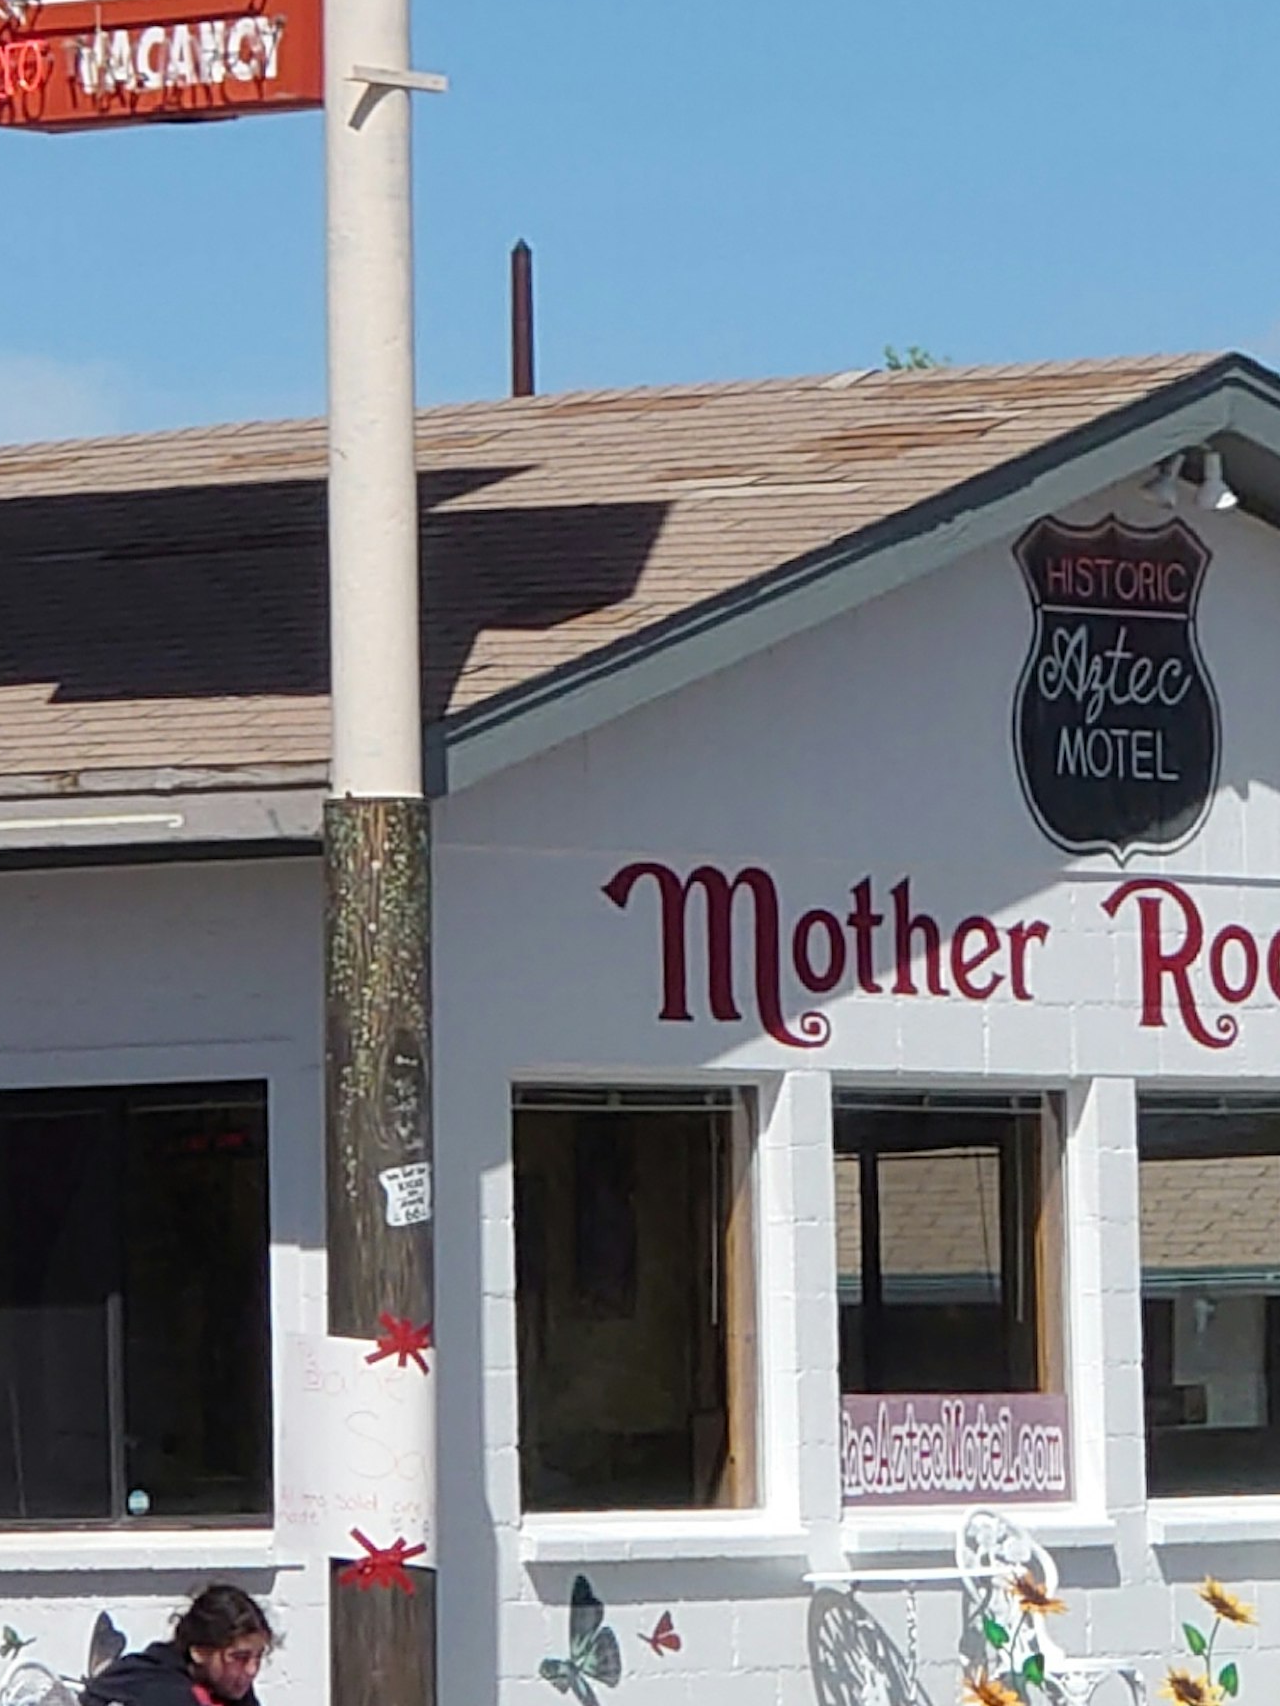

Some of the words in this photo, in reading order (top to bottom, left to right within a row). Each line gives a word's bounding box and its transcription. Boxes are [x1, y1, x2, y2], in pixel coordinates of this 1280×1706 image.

[78, 16, 282, 94] VACANCY
[1045, 556, 1188, 602] HISTORIC
[1038, 625, 1192, 724] Aztec
[1057, 726, 1179, 781] MOTEL
[602, 863, 1049, 1049] Mother
